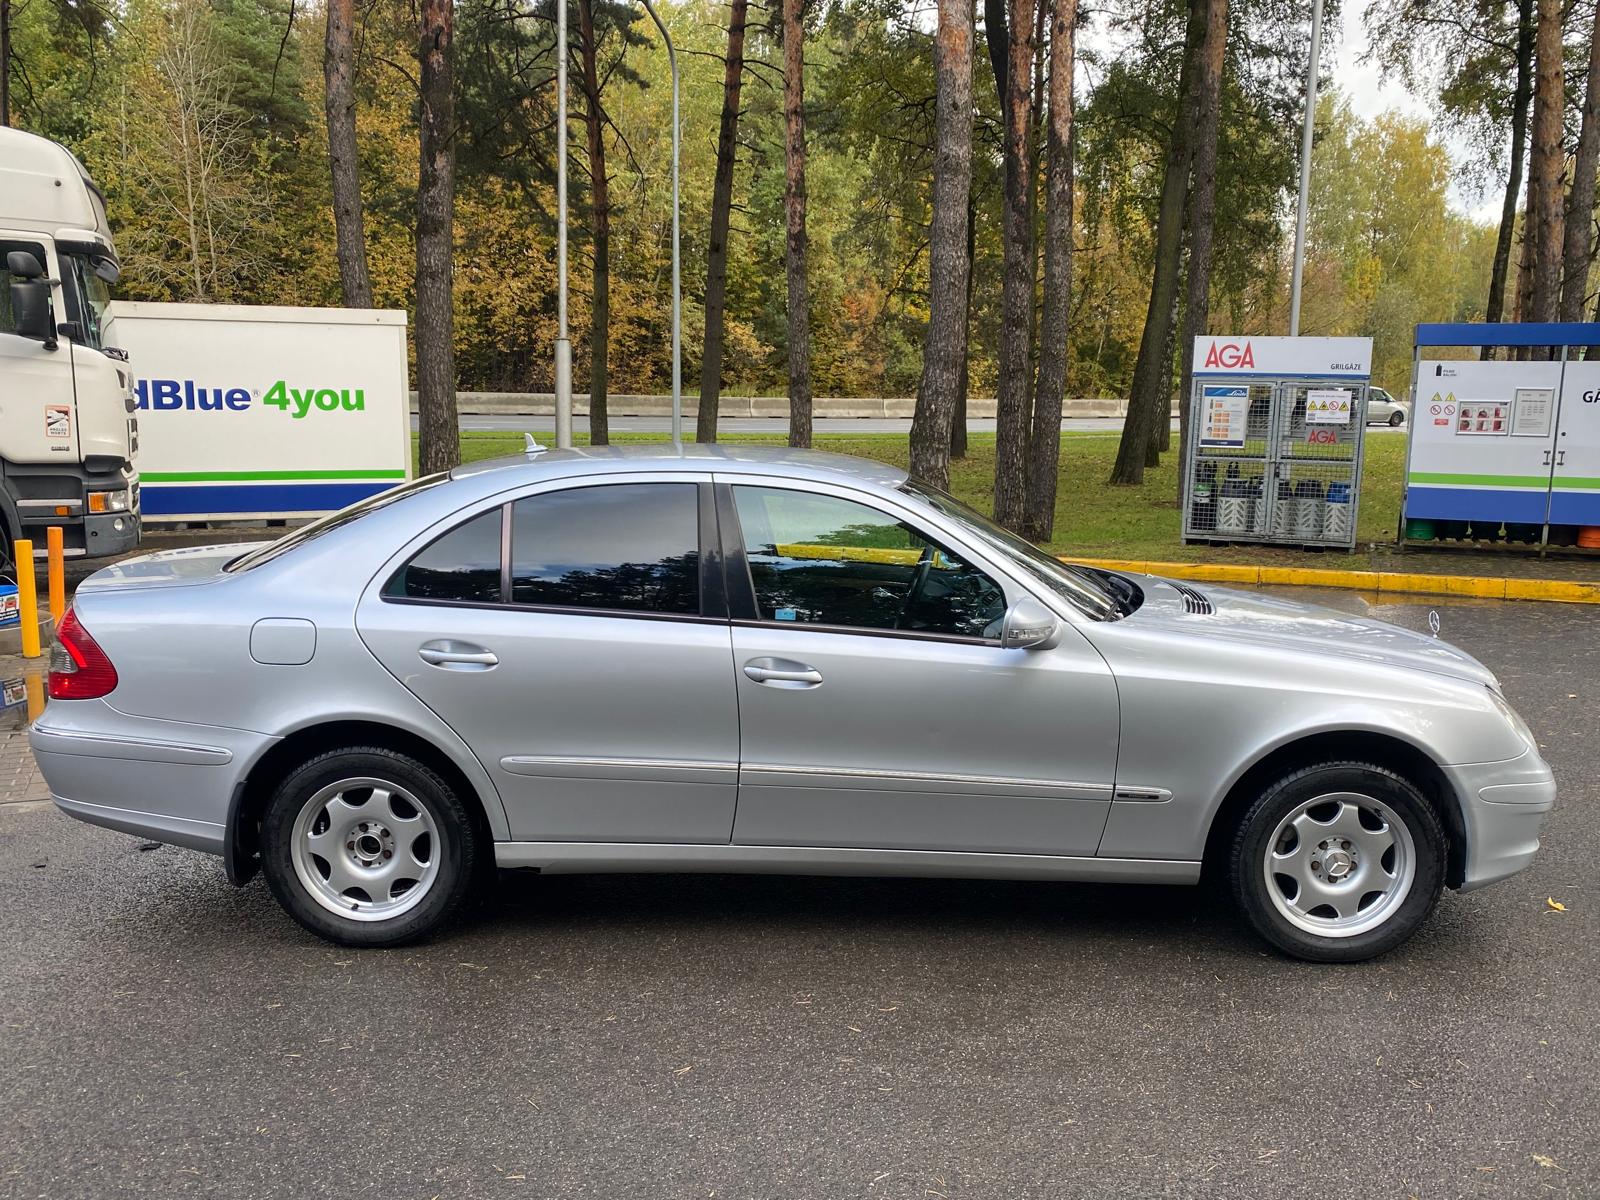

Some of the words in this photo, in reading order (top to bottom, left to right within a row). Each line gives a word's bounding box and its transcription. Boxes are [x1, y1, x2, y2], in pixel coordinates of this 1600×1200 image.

[1204, 340, 1255, 369] AGA
[263, 380, 365, 419] 4you
[1308, 429, 1337, 443] AGA
